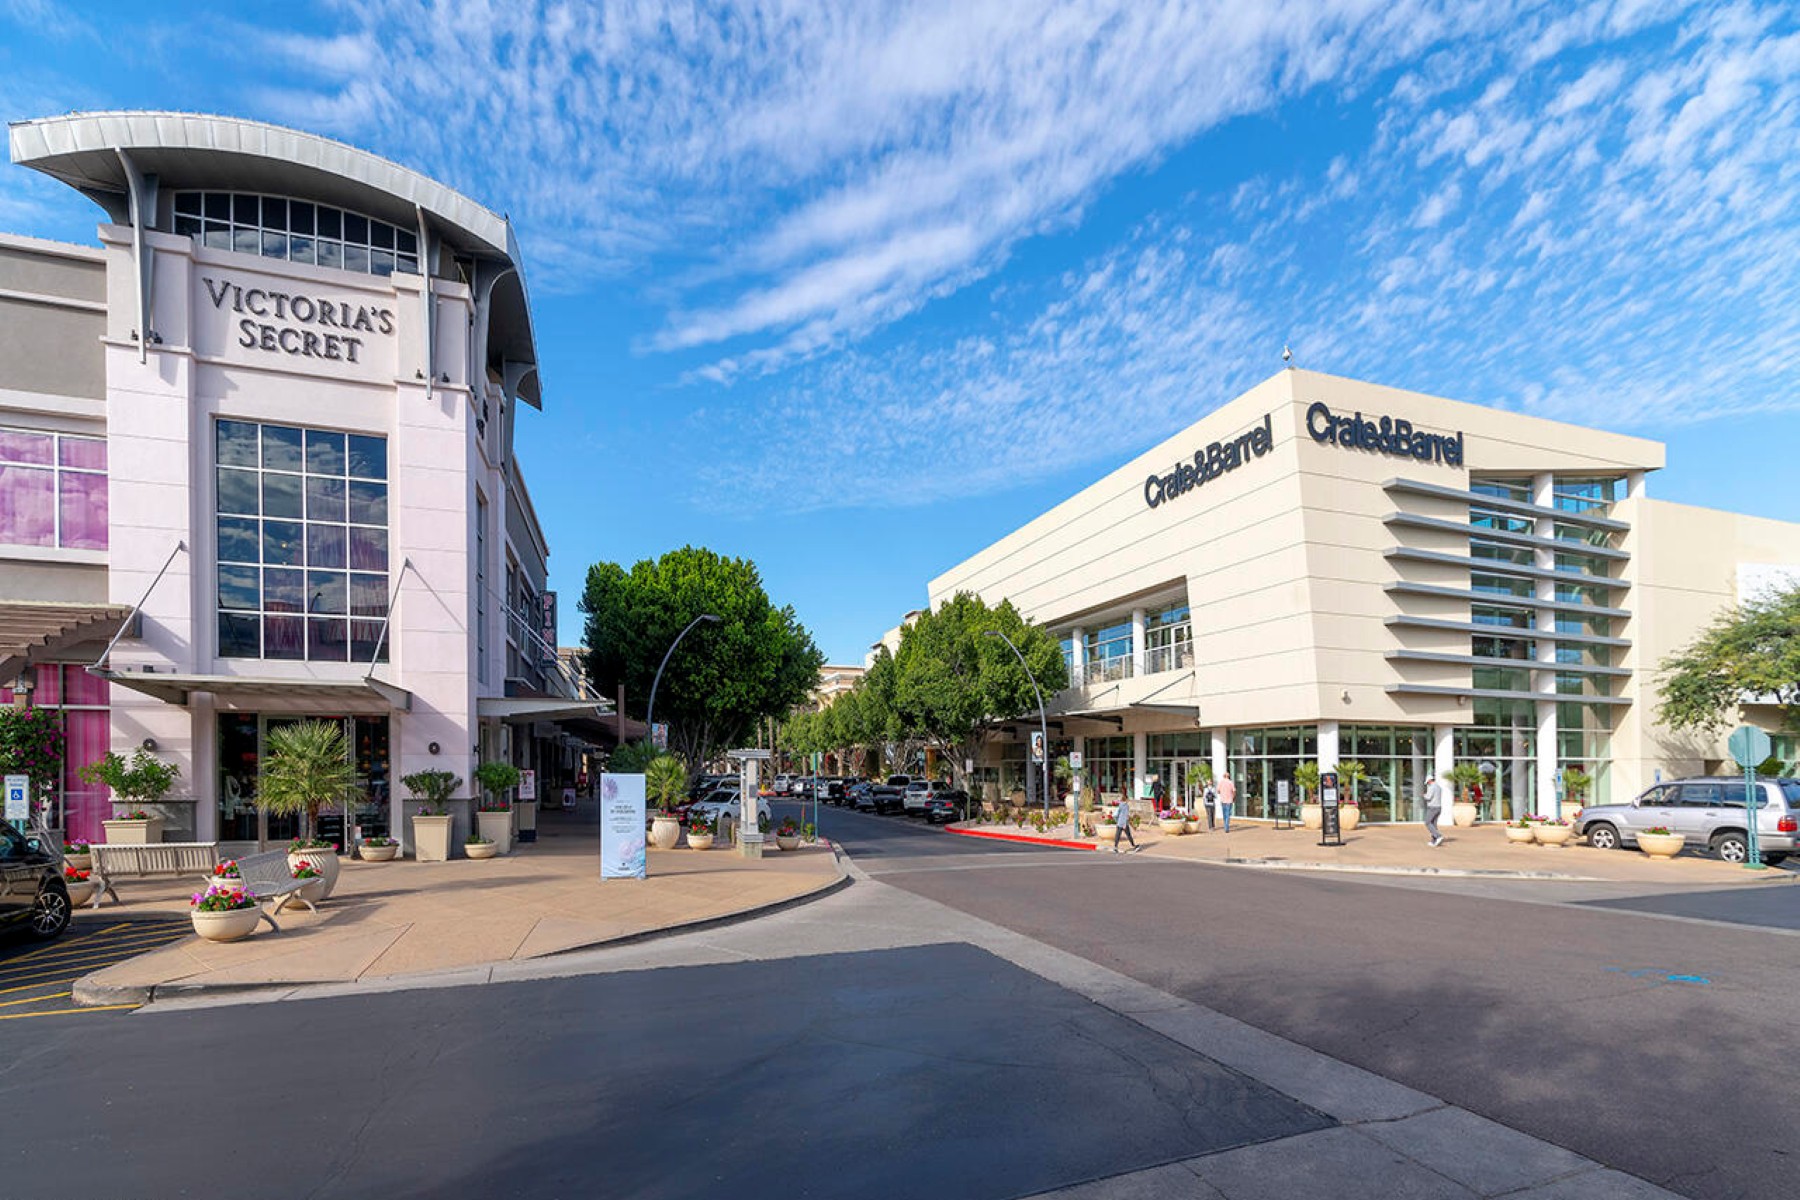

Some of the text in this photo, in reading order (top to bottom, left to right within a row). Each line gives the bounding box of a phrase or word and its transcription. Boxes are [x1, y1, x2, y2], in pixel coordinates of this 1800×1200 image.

[203, 277, 394, 335] VICTORIA'S
[239, 319, 362, 363] SECRET
[1144, 413, 1274, 509] Crate&Barrel
[1306, 401, 1464, 466] Crate&Barrel
